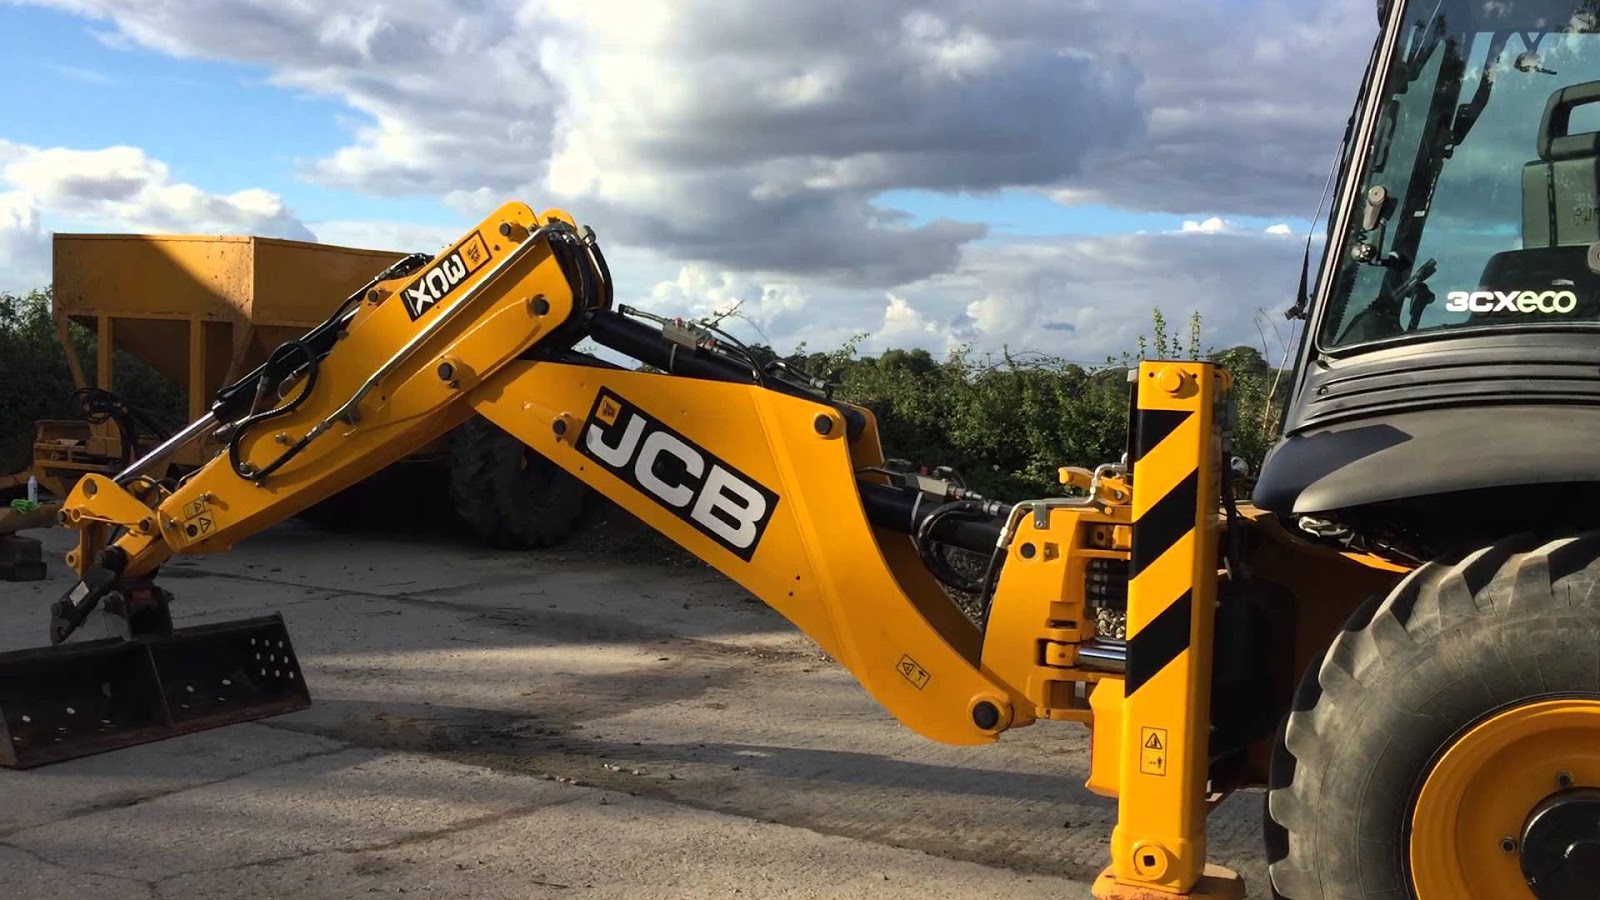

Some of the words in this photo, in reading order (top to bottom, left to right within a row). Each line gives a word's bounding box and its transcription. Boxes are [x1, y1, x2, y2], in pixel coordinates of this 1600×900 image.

[407, 254, 466, 315] 3CX
[1446, 290, 1577, 313] 3CXeco
[586, 413, 767, 548] JCB
